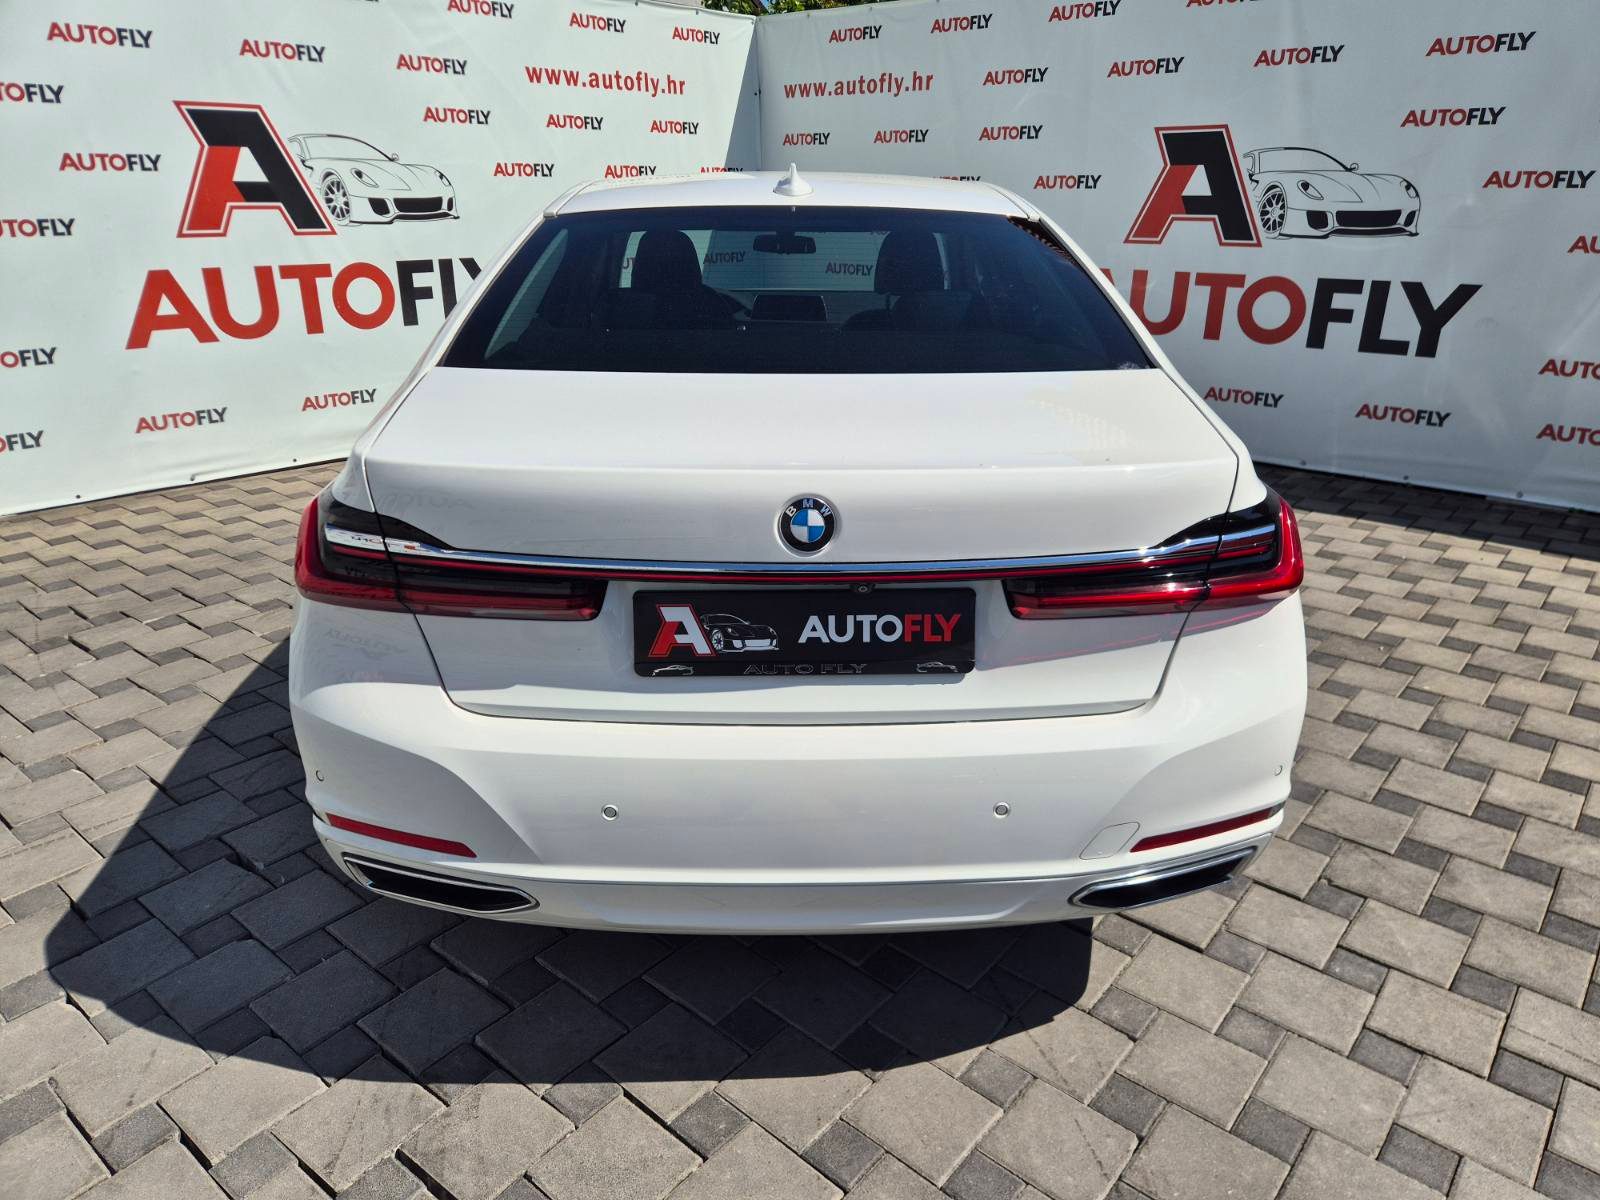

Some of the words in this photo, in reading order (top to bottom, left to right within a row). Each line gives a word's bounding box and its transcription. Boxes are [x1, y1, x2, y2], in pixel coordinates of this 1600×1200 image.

[448, 0, 514, 18] AUTOFLY
[1049, 0, 1121, 22] AUTOFLY
[570, 13, 626, 33] AUTOFLY
[931, 14, 992, 33] AUTOFLY
[47, 22, 152, 48] AUTOFLY
[672, 27, 720, 44] AUTOFLY
[829, 25, 882, 43] AUTOFLY
[1426, 31, 1536, 56] AUTOFLY
[240, 39, 325, 62] AUTOFLY
[1254, 45, 1344, 67] AUTOFLY
[397, 54, 467, 75] AUTOFLY
[1107, 57, 1184, 77] AUTOFLY
[525, 66, 685, 97] www.autofly.hr
[784, 71, 933, 98] www.autofly.hr
[983, 67, 1048, 85] AUTOFLY
[424, 107, 490, 124] AUTOFLY
[547, 114, 603, 130] AUTOFLY
[1401, 107, 1506, 127] AUTOFLY
[650, 120, 699, 134] AUTOFLY
[874, 129, 928, 143] AUTOFLY
[979, 125, 1043, 141] AUTOFLY
[783, 133, 830, 146] AUTOFLY
[59, 153, 161, 171] AUTOFLY
[494, 163, 554, 177] AUTOFLY
[1034, 175, 1101, 189] AUTOFLY
[1483, 171, 1596, 188] AUTOFLY
[0, 218, 75, 237] TOFLY
[825, 261, 873, 276] AUTOFLY
[1100, 268, 1483, 358] UTOFLY
[302, 389, 376, 411] AUTOFLY
[1204, 387, 1284, 408] AUTOFLY
[136, 407, 227, 433] AUTOFLY
[1355, 404, 1451, 427] AUTOFLY
[785, 498, 831, 517] BMW
[798, 613, 961, 644] AUTOFLY
[743, 663, 814, 675] AUTO
[820, 663, 867, 674] FLY
